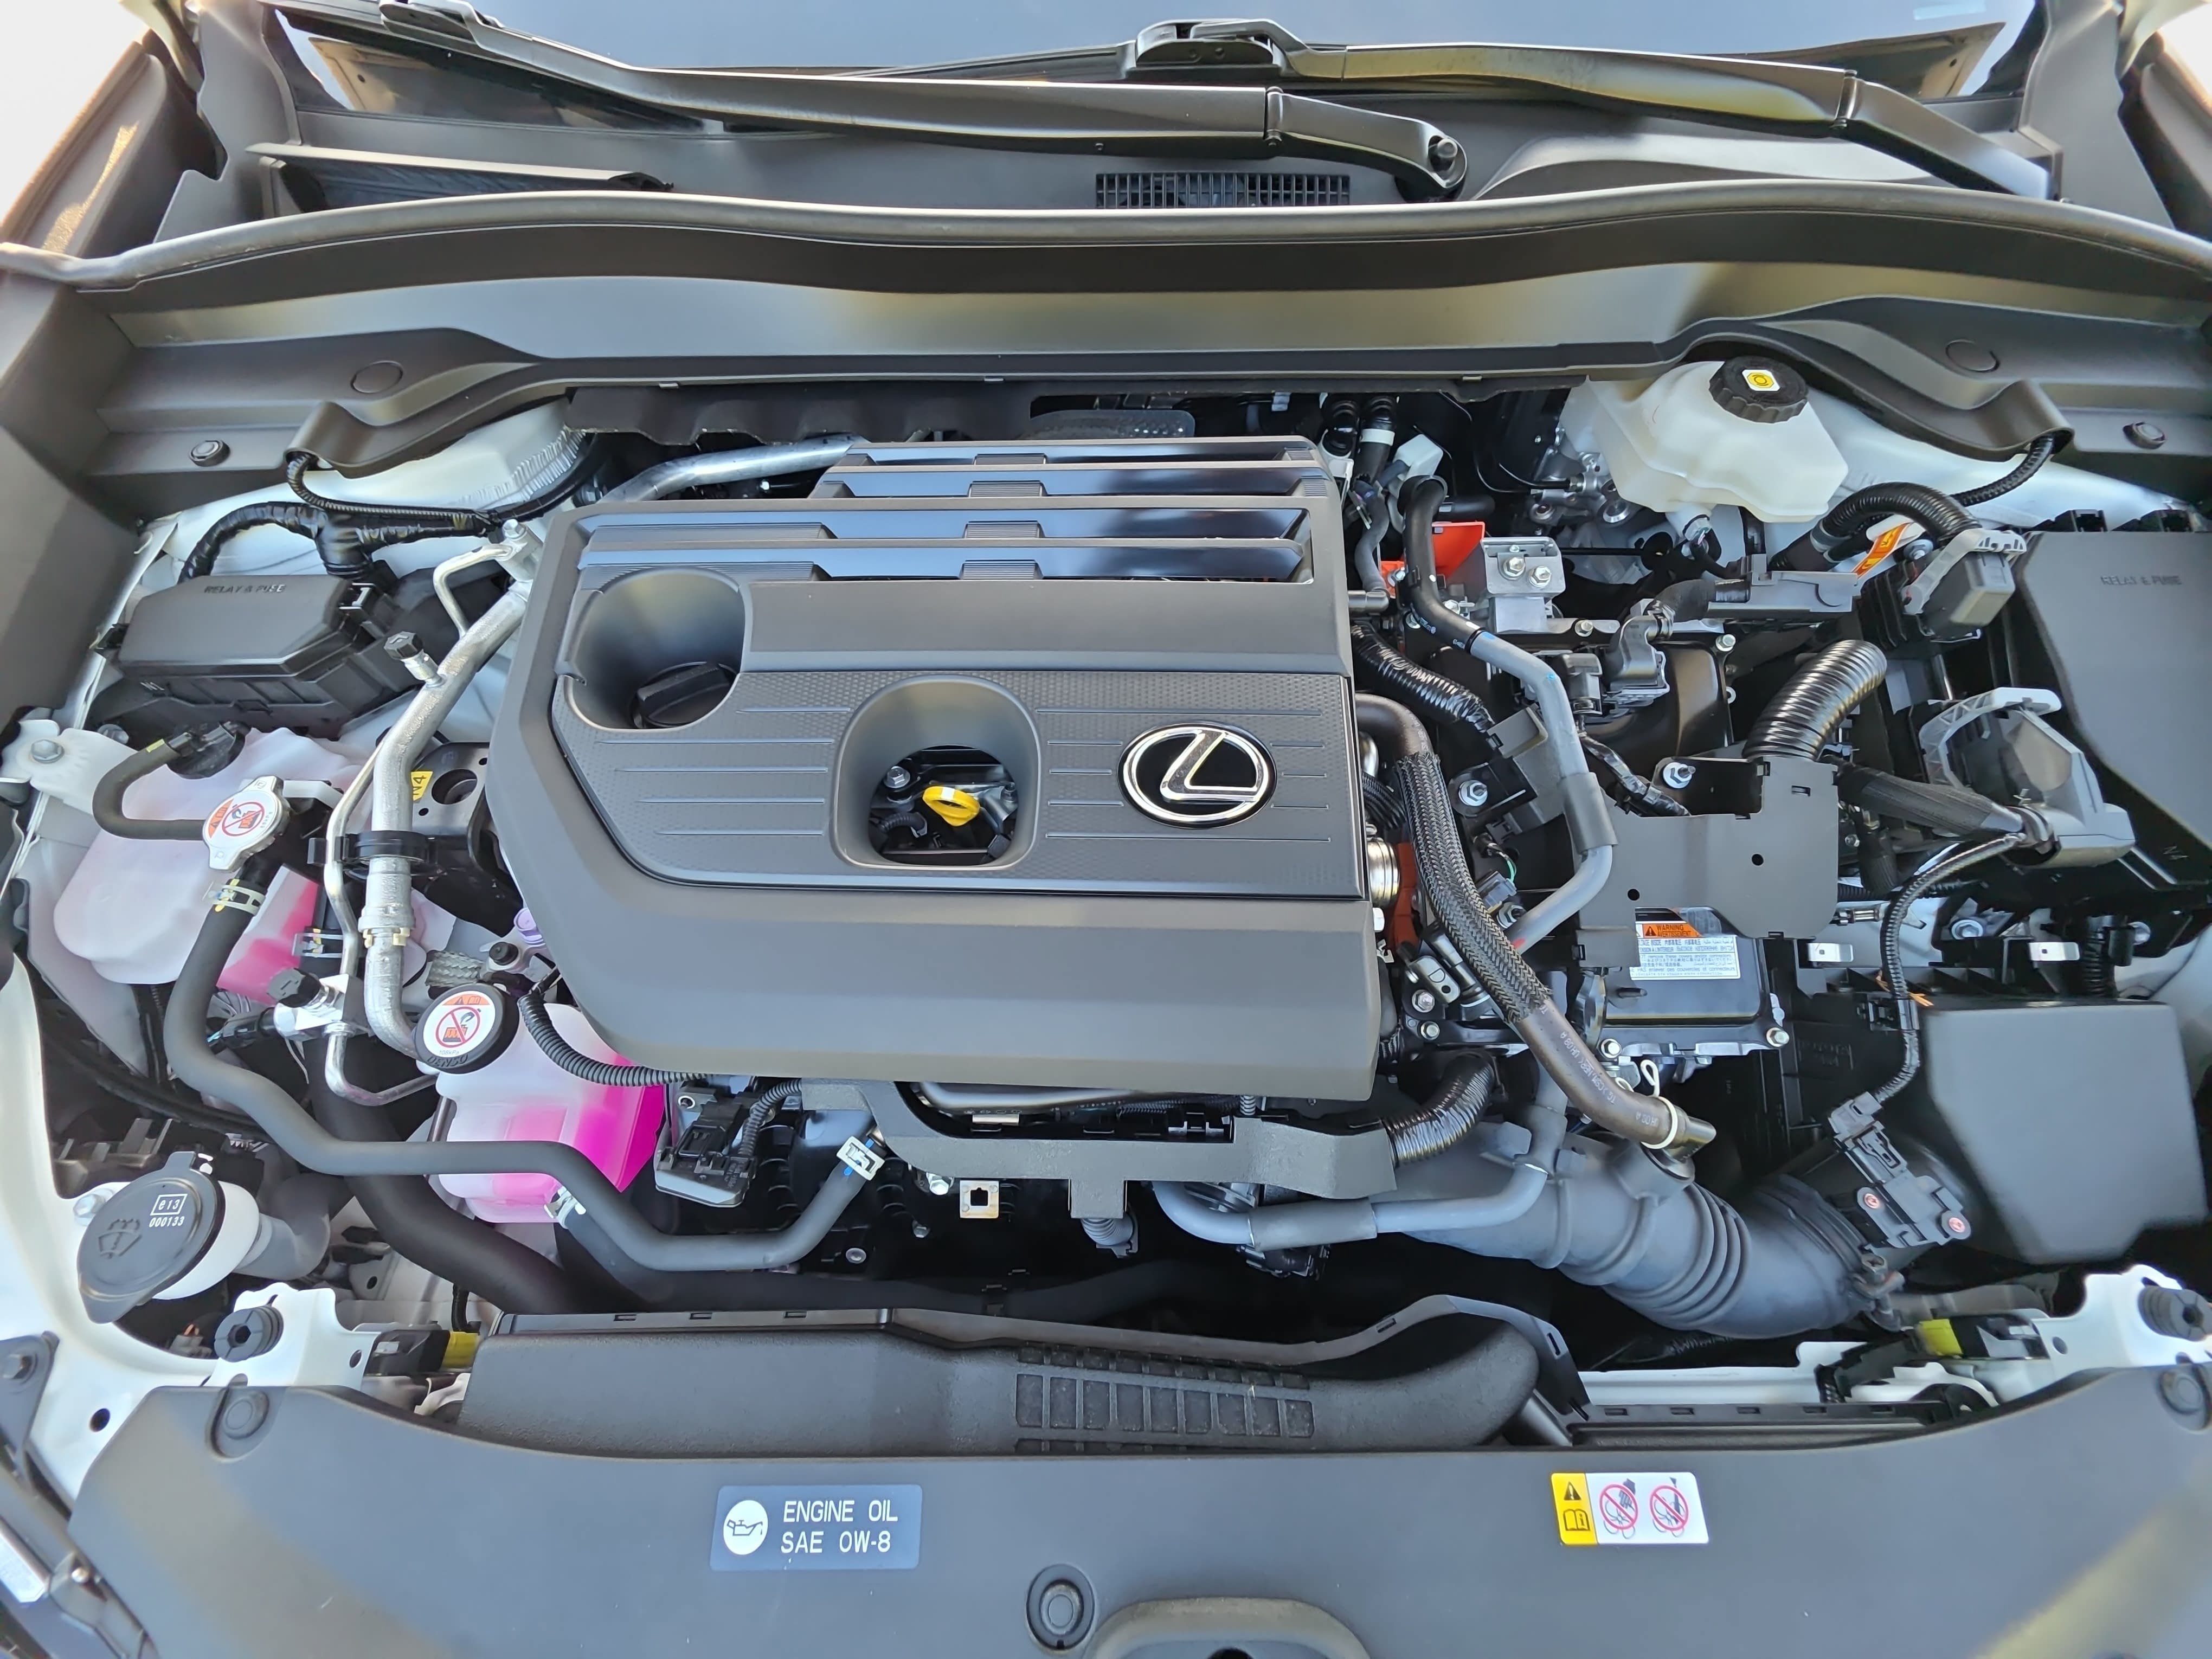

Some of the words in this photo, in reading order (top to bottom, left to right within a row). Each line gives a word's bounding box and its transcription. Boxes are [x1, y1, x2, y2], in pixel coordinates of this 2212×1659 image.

[2100, 575, 2137, 586] RELAY
[204, 585, 242, 594] RELAY
[255, 584, 286, 593] FUSE
[427, 1053, 468, 1068] DENSO
[158, 1199, 181, 1211] e13
[149, 1216, 185, 1227] 000133
[783, 1500, 855, 1522] ENGINE
[869, 1500, 898, 1521] OIL
[781, 1531, 824, 1553] SAE
[839, 1530, 891, 1553] 0W-8
